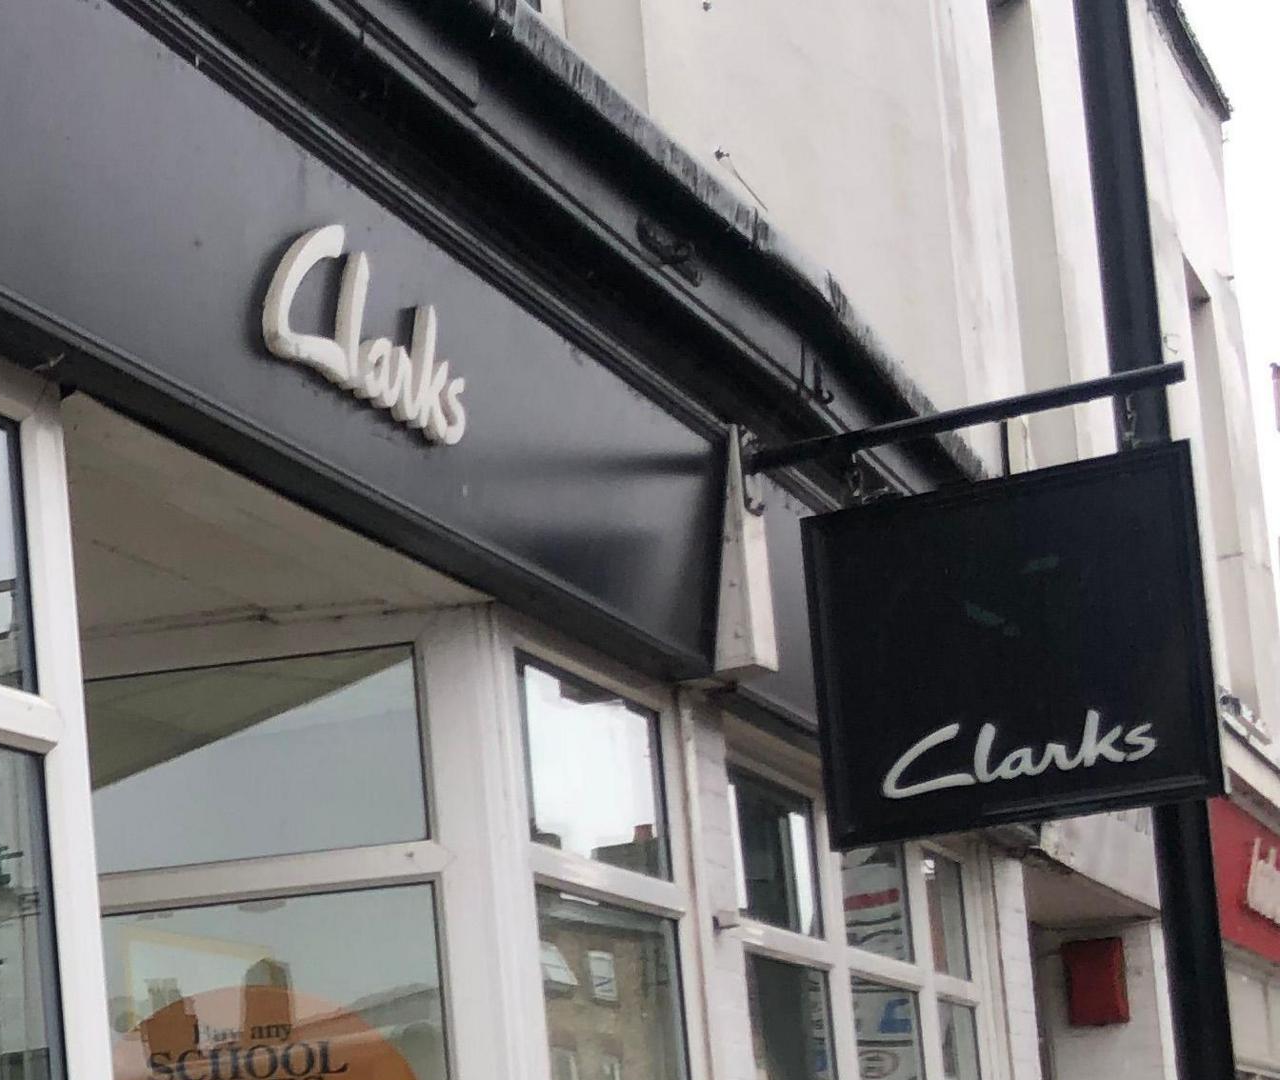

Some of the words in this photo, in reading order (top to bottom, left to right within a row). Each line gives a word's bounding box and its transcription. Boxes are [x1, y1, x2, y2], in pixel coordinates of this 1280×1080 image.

[262, 224, 466, 445] Clarks
[883, 709, 1158, 799] Clarks
[251, 1024, 291, 1041] any
